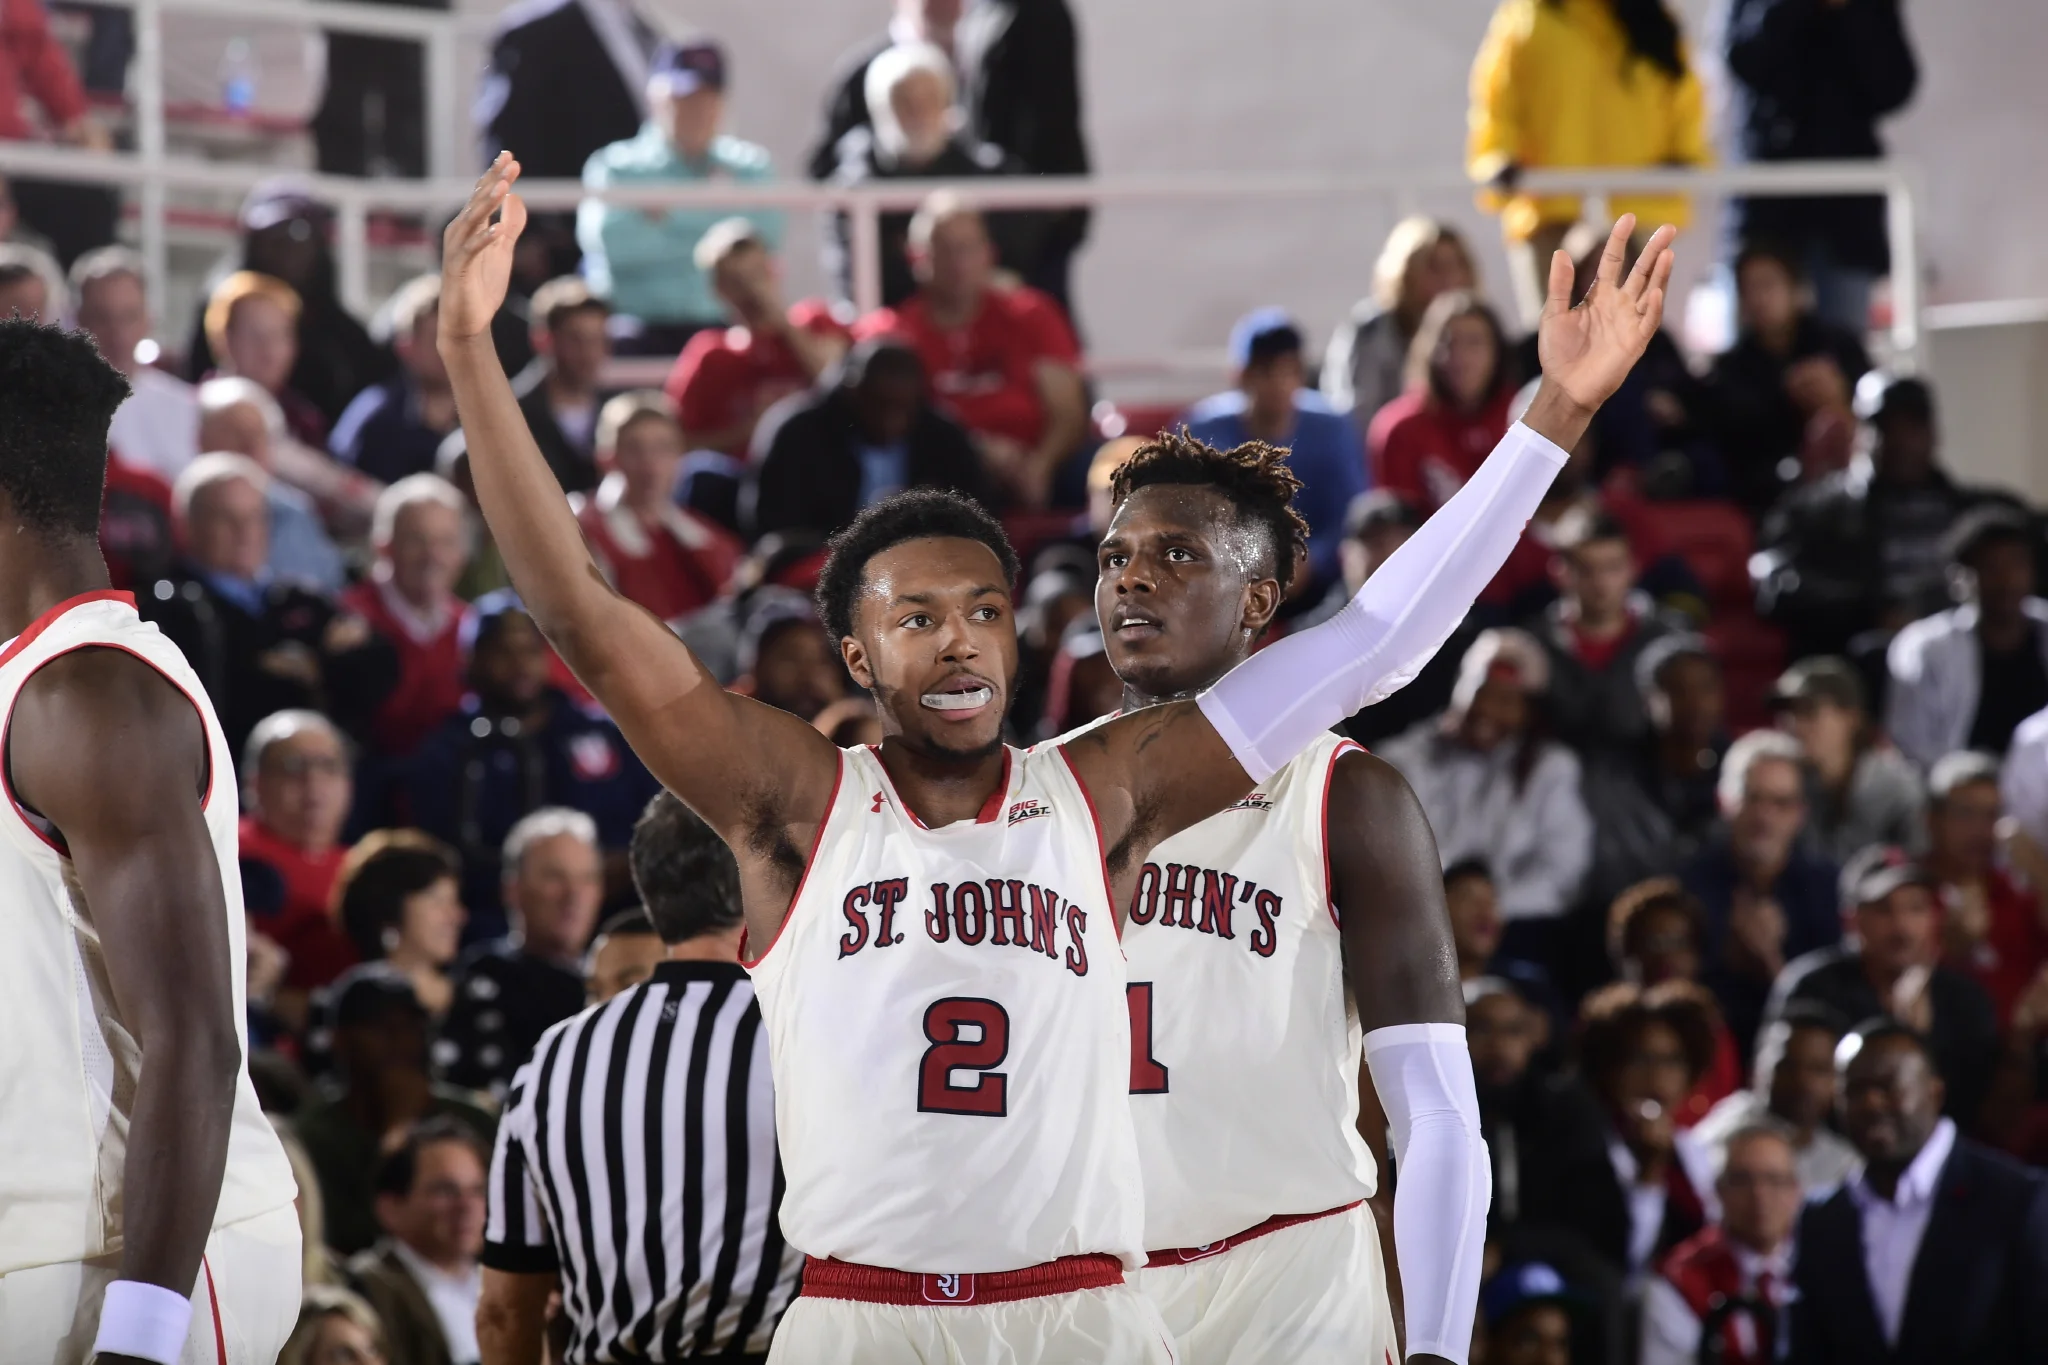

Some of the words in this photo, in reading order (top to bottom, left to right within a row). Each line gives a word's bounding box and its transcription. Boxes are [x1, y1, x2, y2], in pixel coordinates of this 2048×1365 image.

[1008, 806, 1050, 823] EAST
[1009, 799, 1038, 815] BIG
[1244, 793, 1267, 801] IG
[838, 876, 909, 960] ST.
[924, 878, 1089, 977] JOHN'S
[1129, 862, 1283, 958] OHN'S
[917, 996, 1010, 1118] 2
[1125, 981, 1170, 1095] 1
